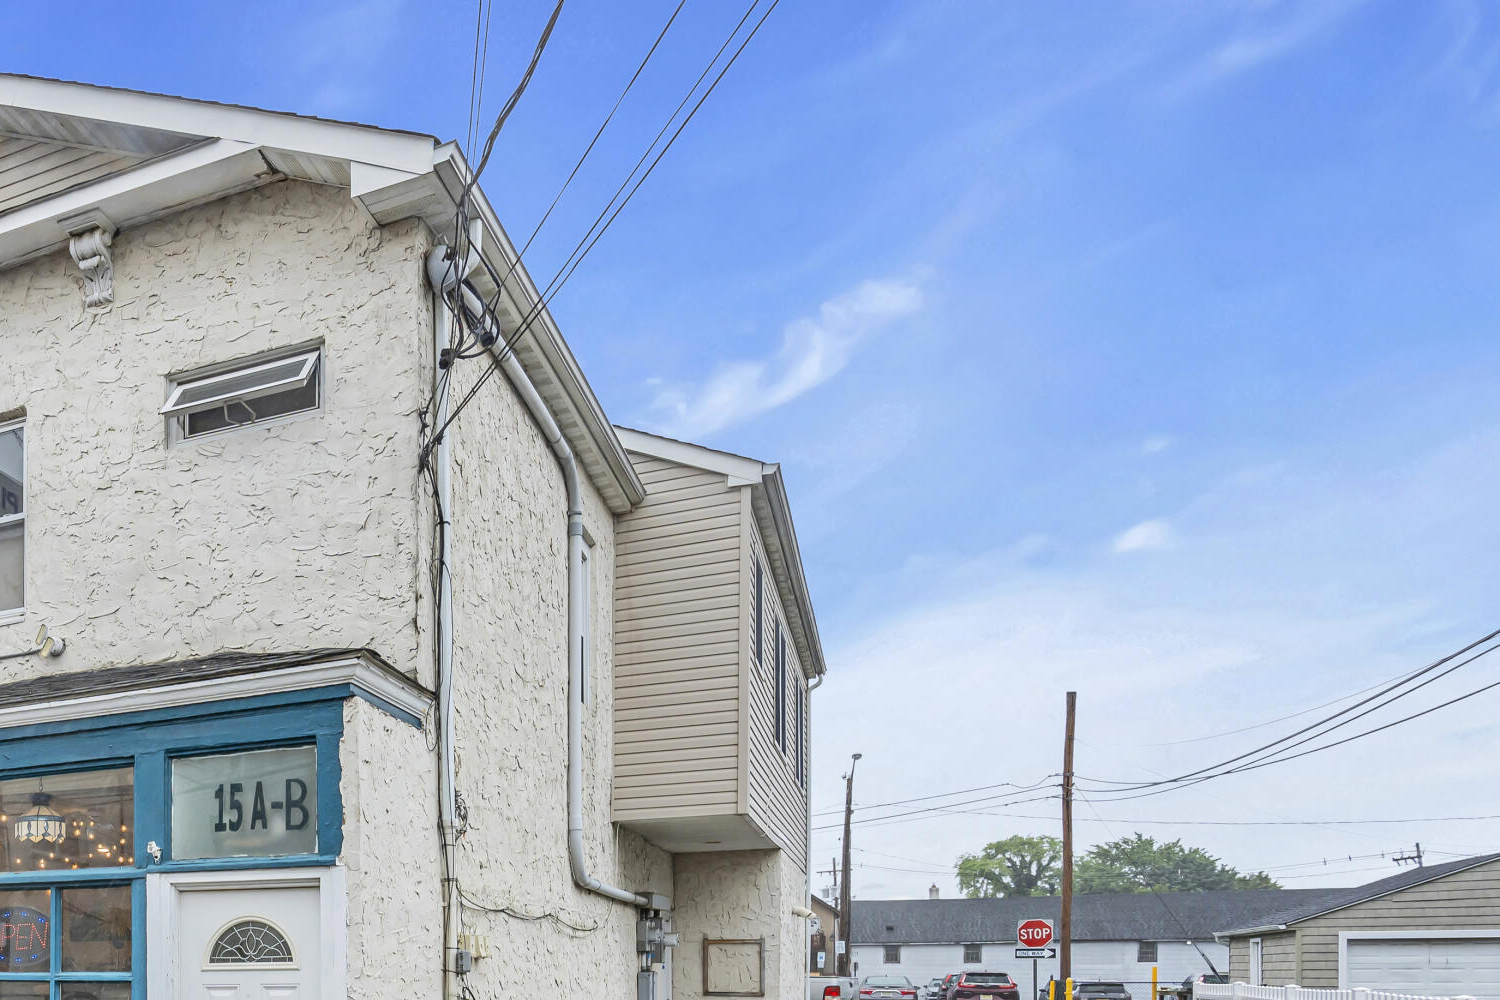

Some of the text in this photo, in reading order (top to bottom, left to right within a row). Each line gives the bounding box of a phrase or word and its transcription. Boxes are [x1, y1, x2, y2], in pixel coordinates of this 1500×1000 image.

[214, 778, 310, 833] 15 A-B
[1020, 928, 1050, 939] STOP
